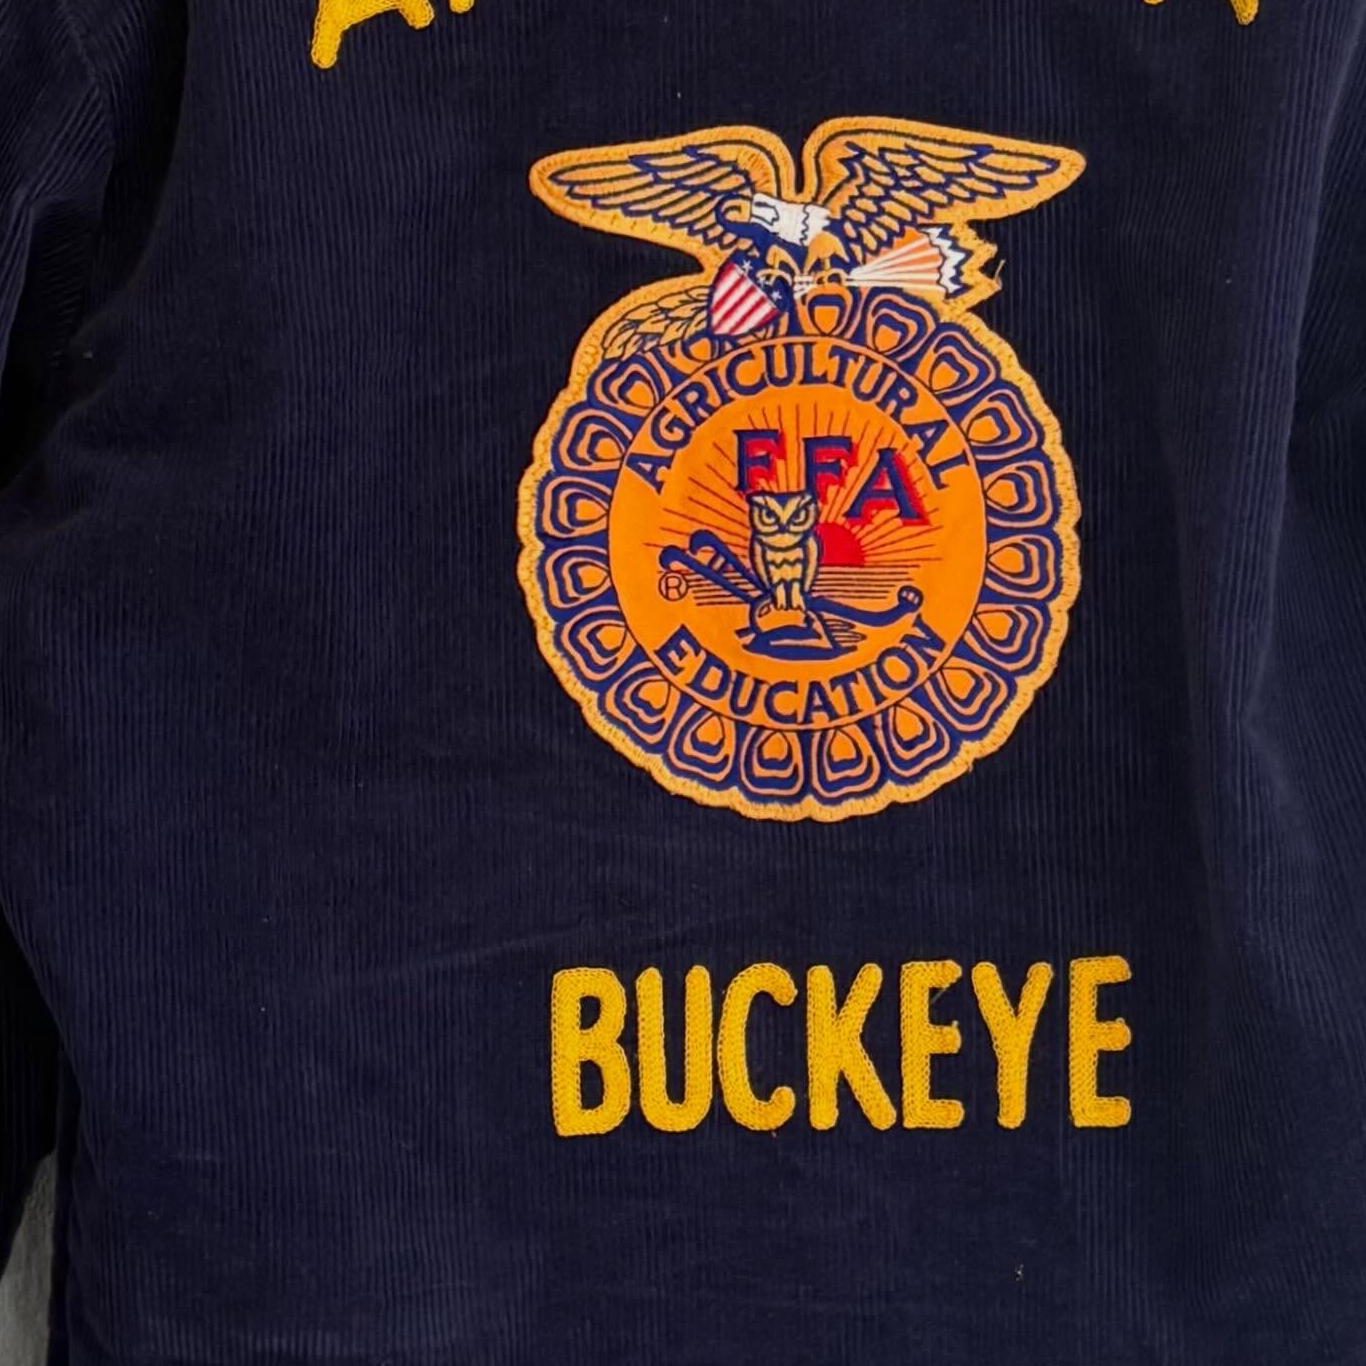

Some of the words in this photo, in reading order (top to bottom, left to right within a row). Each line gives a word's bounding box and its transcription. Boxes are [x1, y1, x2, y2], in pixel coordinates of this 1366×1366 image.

[625, 338, 968, 496] AGRICULTURAL
[734, 428, 930, 526] FFA
[654, 622, 953, 725] EDUCATION
[550, 955, 1131, 1136] BUCKEYE
